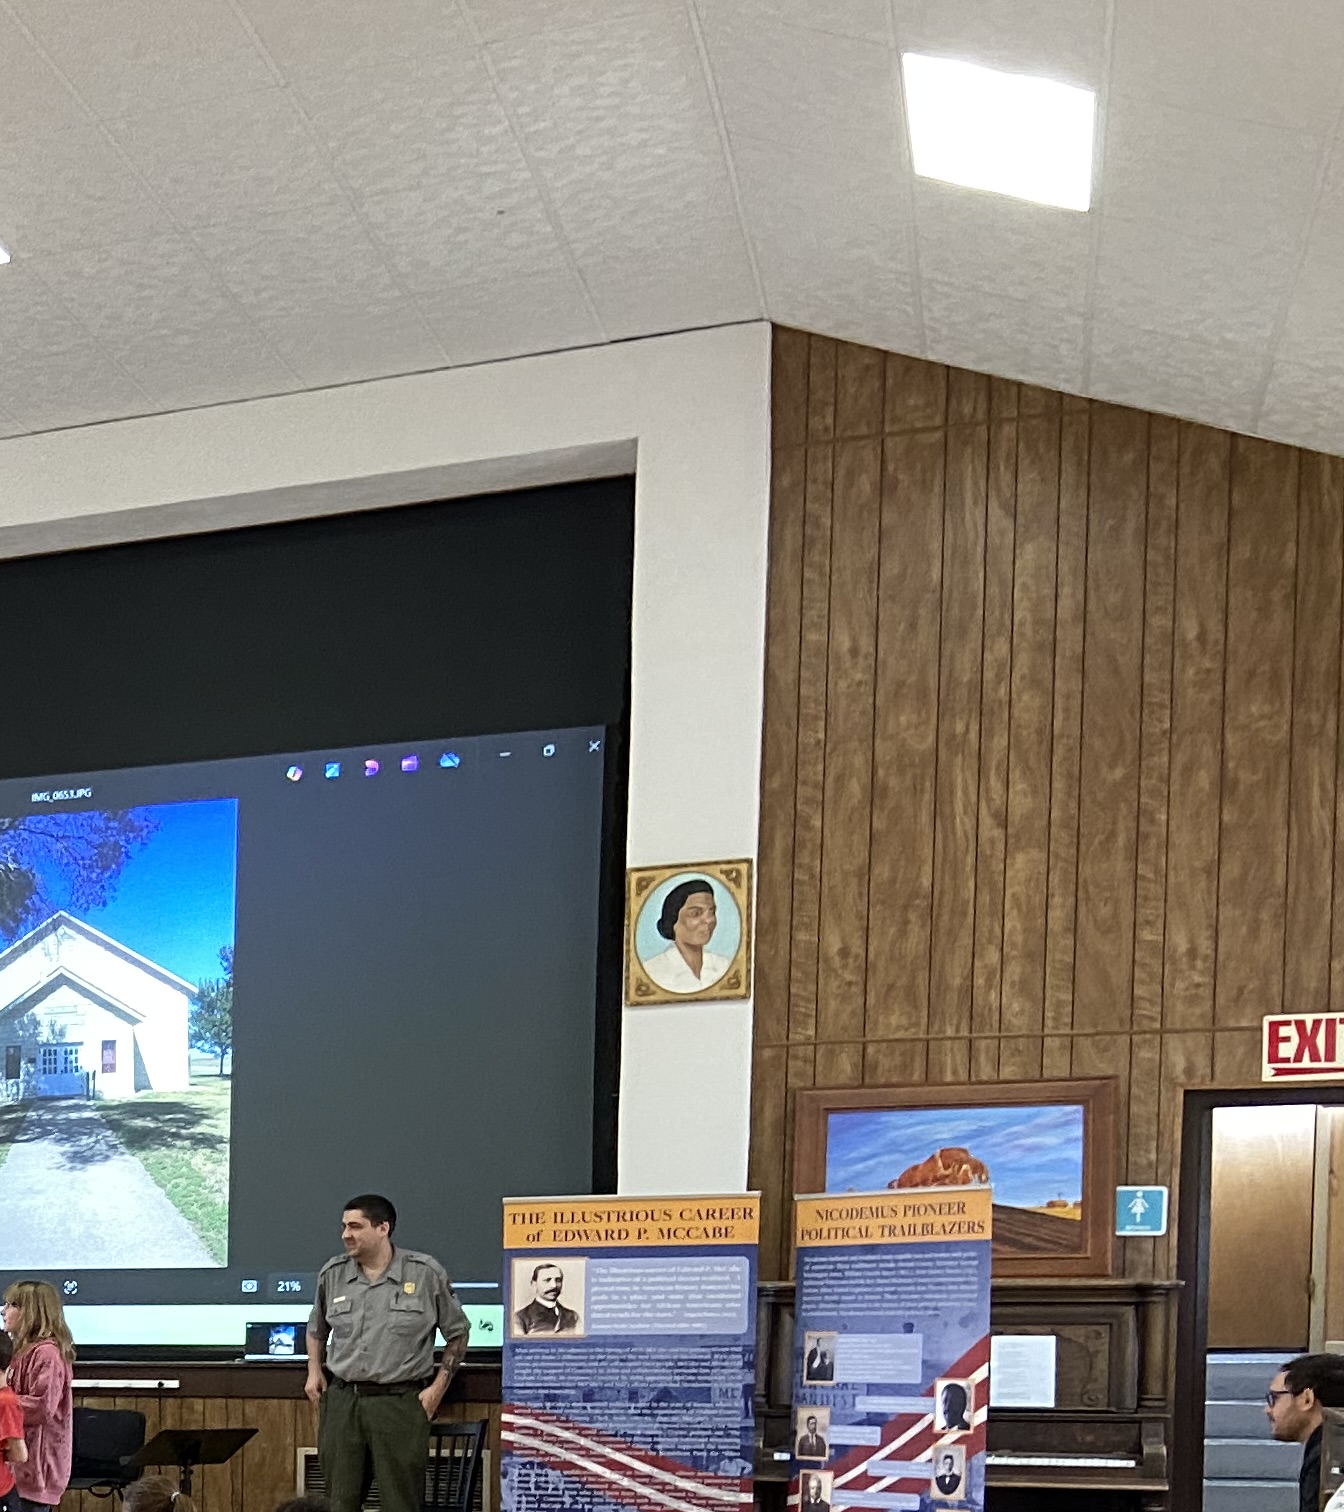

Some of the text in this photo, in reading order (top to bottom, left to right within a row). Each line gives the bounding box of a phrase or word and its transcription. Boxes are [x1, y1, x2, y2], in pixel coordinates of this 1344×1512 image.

[509, 1206, 755, 1226] THE ILLUSTRIOUS CAREER
[815, 1201, 967, 1223] NICODEMUS PIONEER
[525, 1225, 736, 1243] of EDWARD P. MCCABE
[801, 1219, 986, 1242] POLITICAL TRAILBLAZERS
[277, 1280, 301, 1292] 21%
